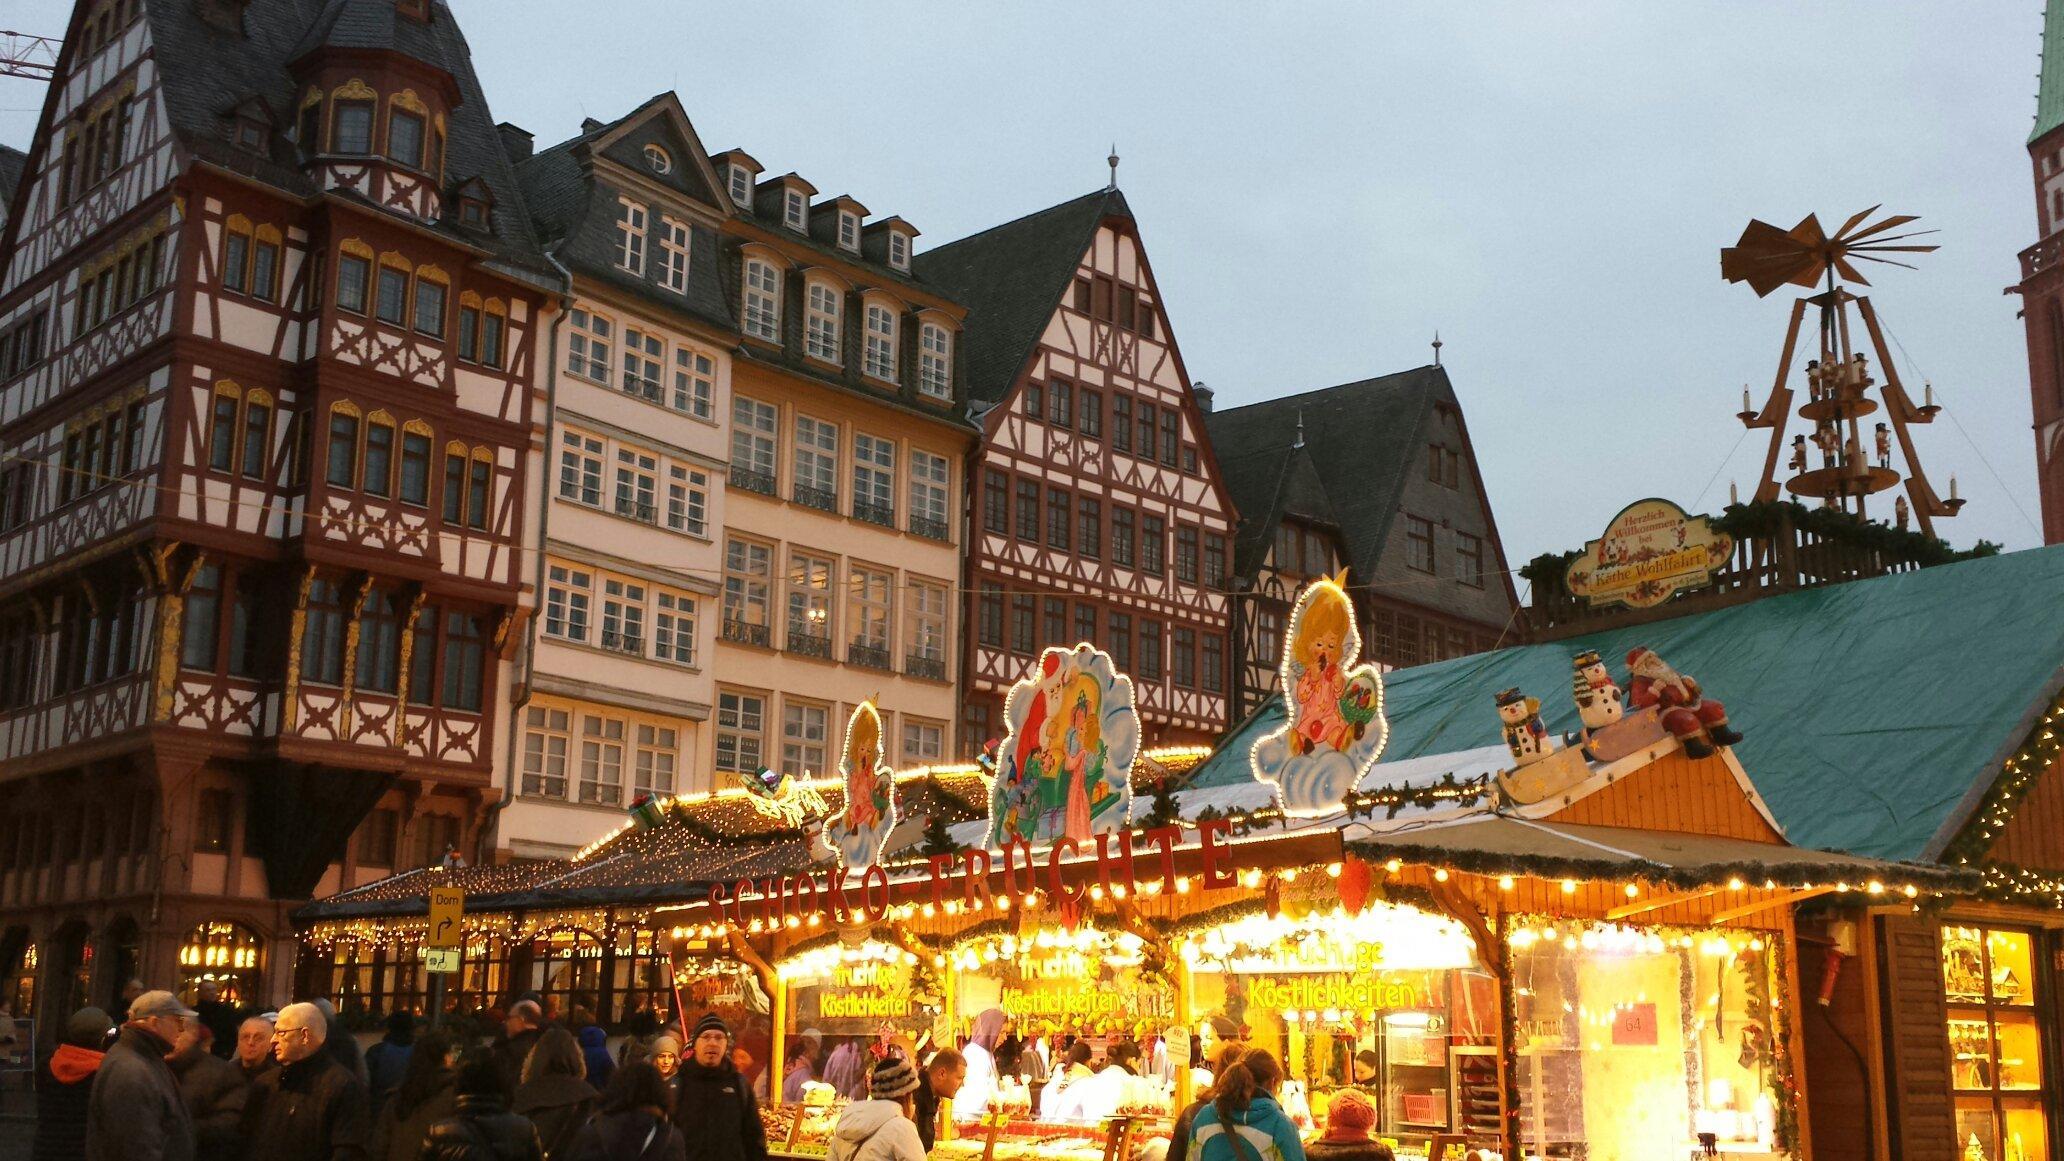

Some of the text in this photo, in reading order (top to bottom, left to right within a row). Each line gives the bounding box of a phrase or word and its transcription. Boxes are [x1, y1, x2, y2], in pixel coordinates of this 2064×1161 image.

[1625, 509, 1665, 527] Herzlich
[1615, 519, 1677, 539] Willkommen
[1639, 534, 1653, 543] bei
[1636, 553, 1701, 577] Wohlfahrt
[436, 894, 459, 905] Dom
[1002, 986, 1121, 1014] Köstlichkeiten
[1249, 974, 1417, 1009] Köstlichkeiten
[819, 990, 913, 1018] Köstlichkeiten
[1625, 1017, 1642, 1032] 64
